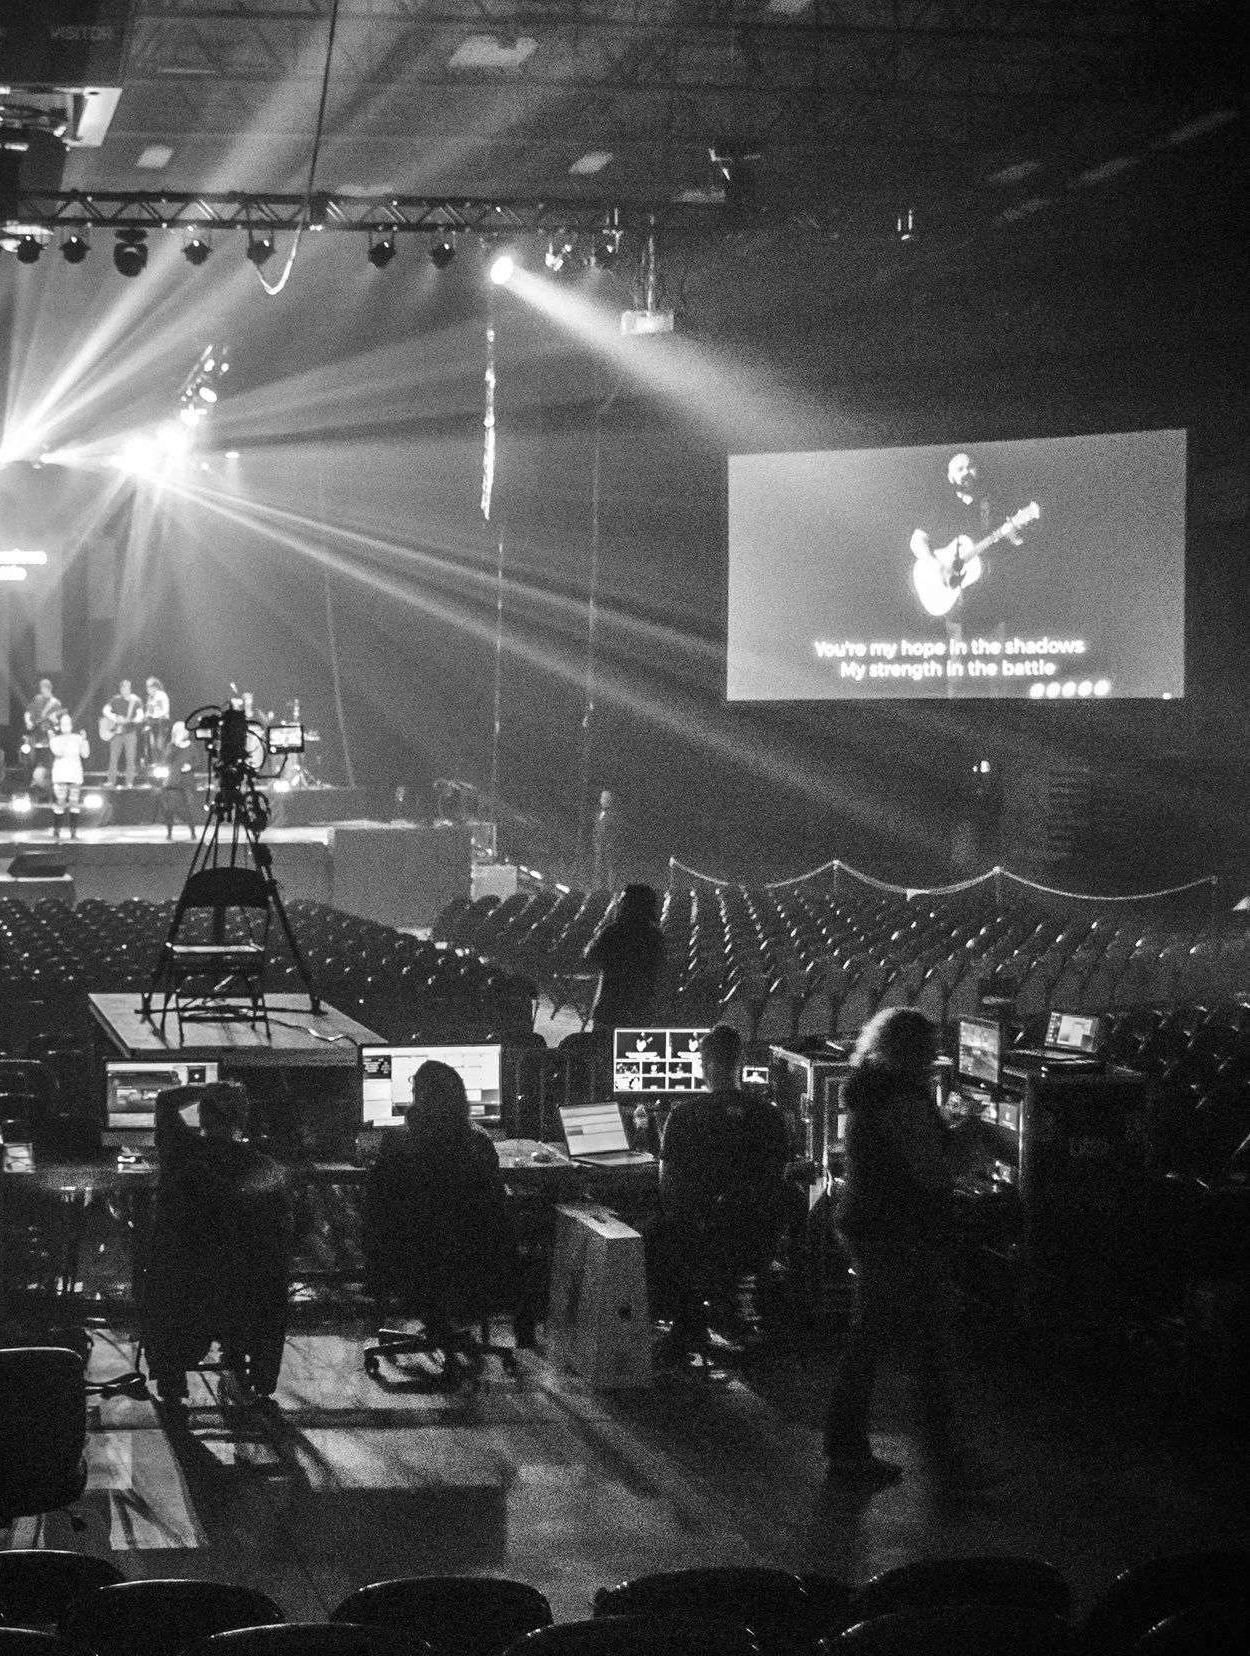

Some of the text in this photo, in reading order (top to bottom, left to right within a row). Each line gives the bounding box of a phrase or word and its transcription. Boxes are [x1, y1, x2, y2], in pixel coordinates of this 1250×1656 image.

[814, 637, 1086, 659] You're my hope in the shadows
[841, 659, 1056, 680] My strength in the battle
